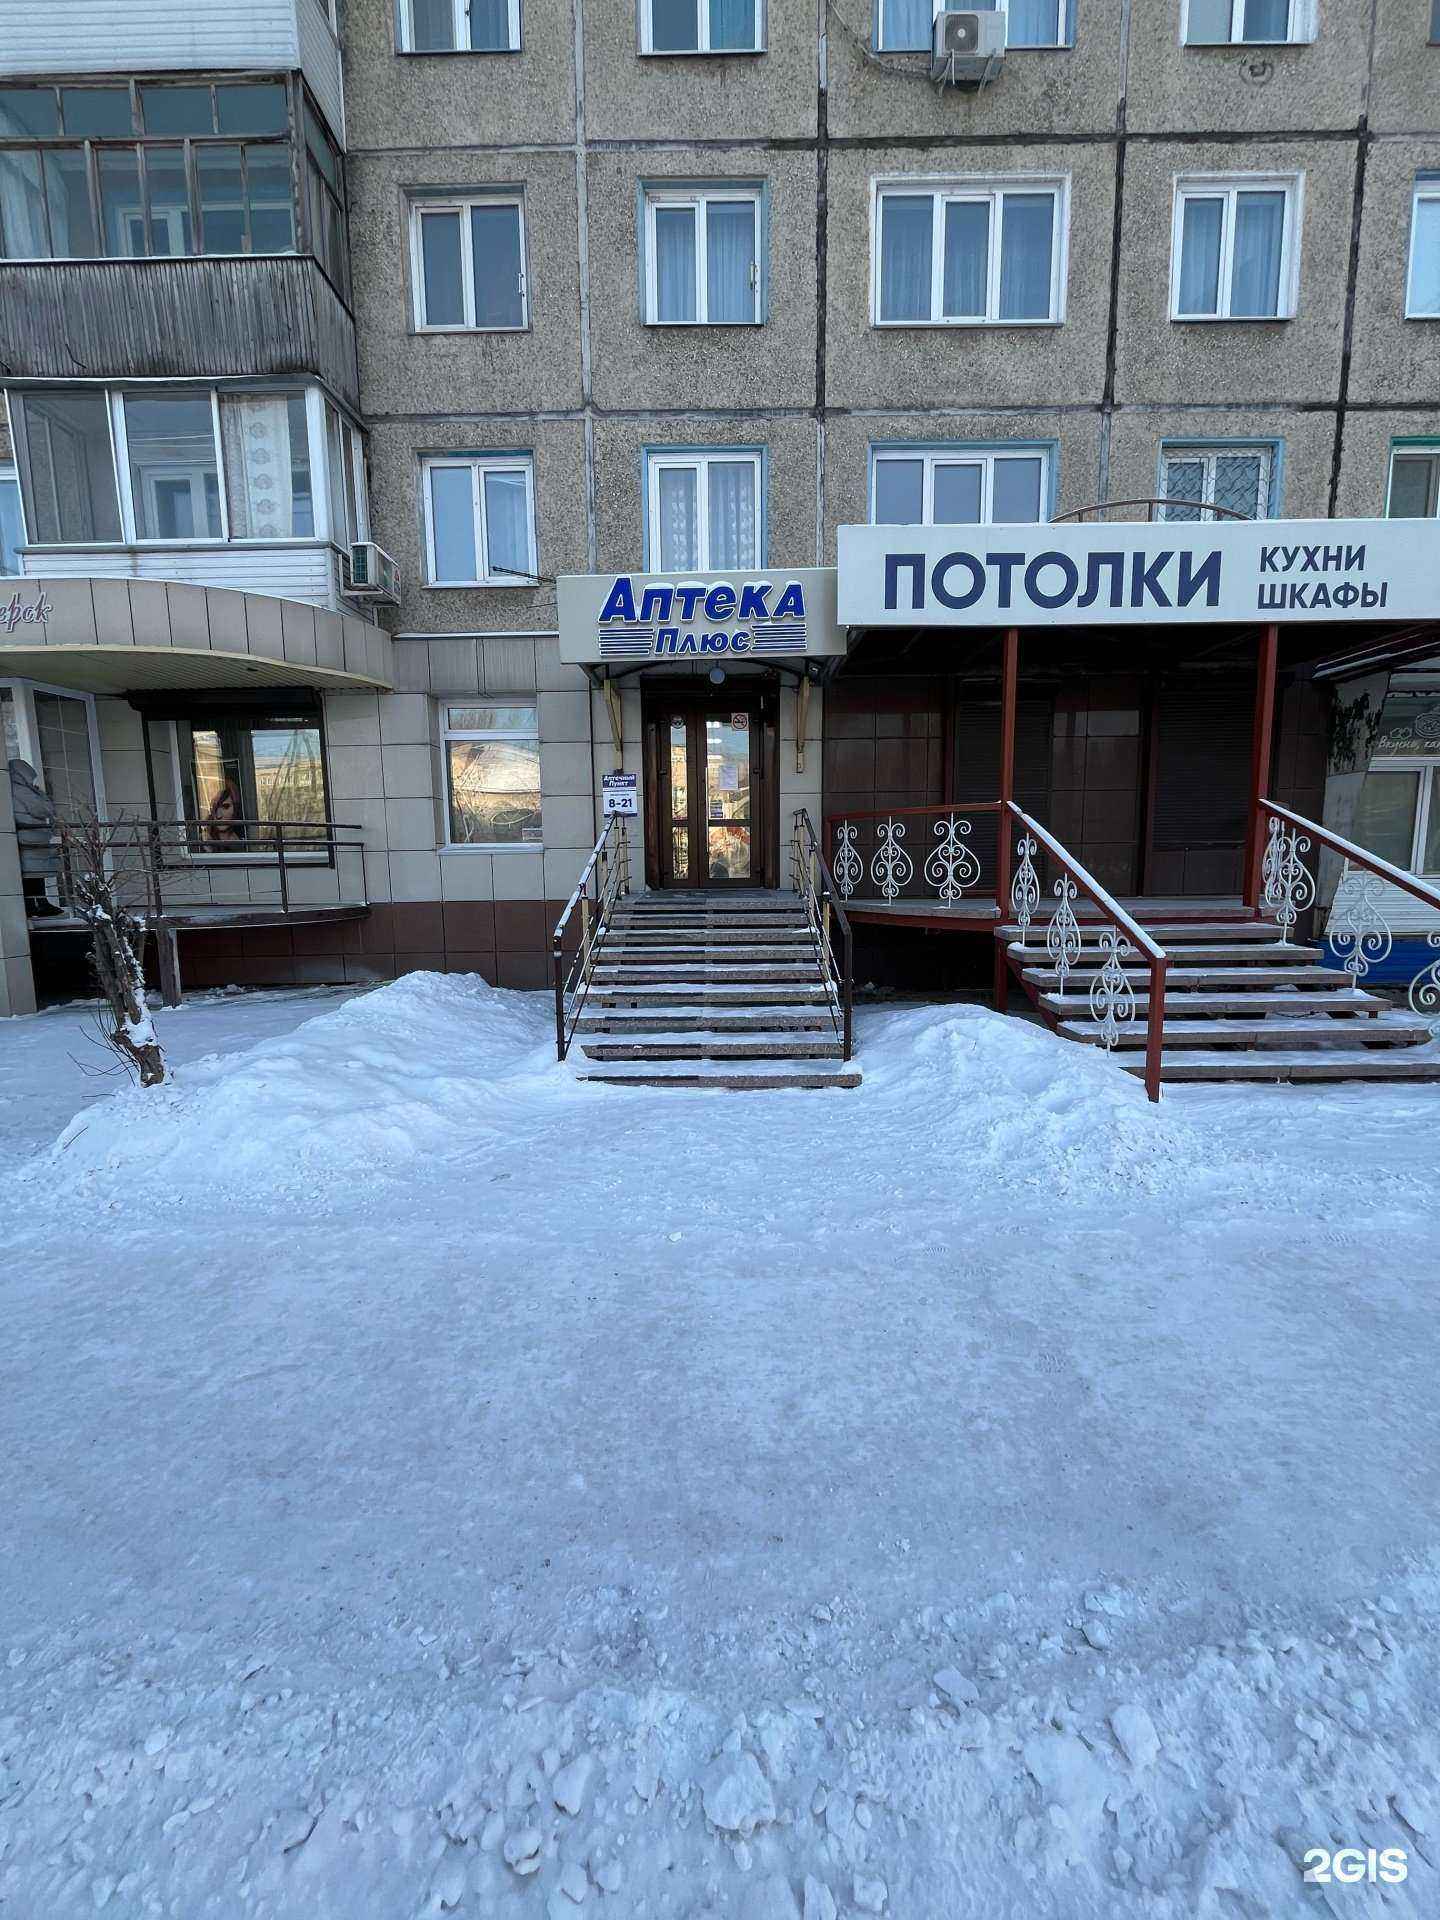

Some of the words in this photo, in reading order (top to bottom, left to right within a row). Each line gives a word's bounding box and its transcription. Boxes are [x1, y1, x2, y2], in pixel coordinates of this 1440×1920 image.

[1259, 545, 1367, 573] КУХНИ
[885, 551, 1222, 610] ПОТОЛКИ
[1257, 581, 1388, 610] ШКАФЫ
[653, 626, 753, 656] Плюс
[608, 798, 633, 808] 8-21
